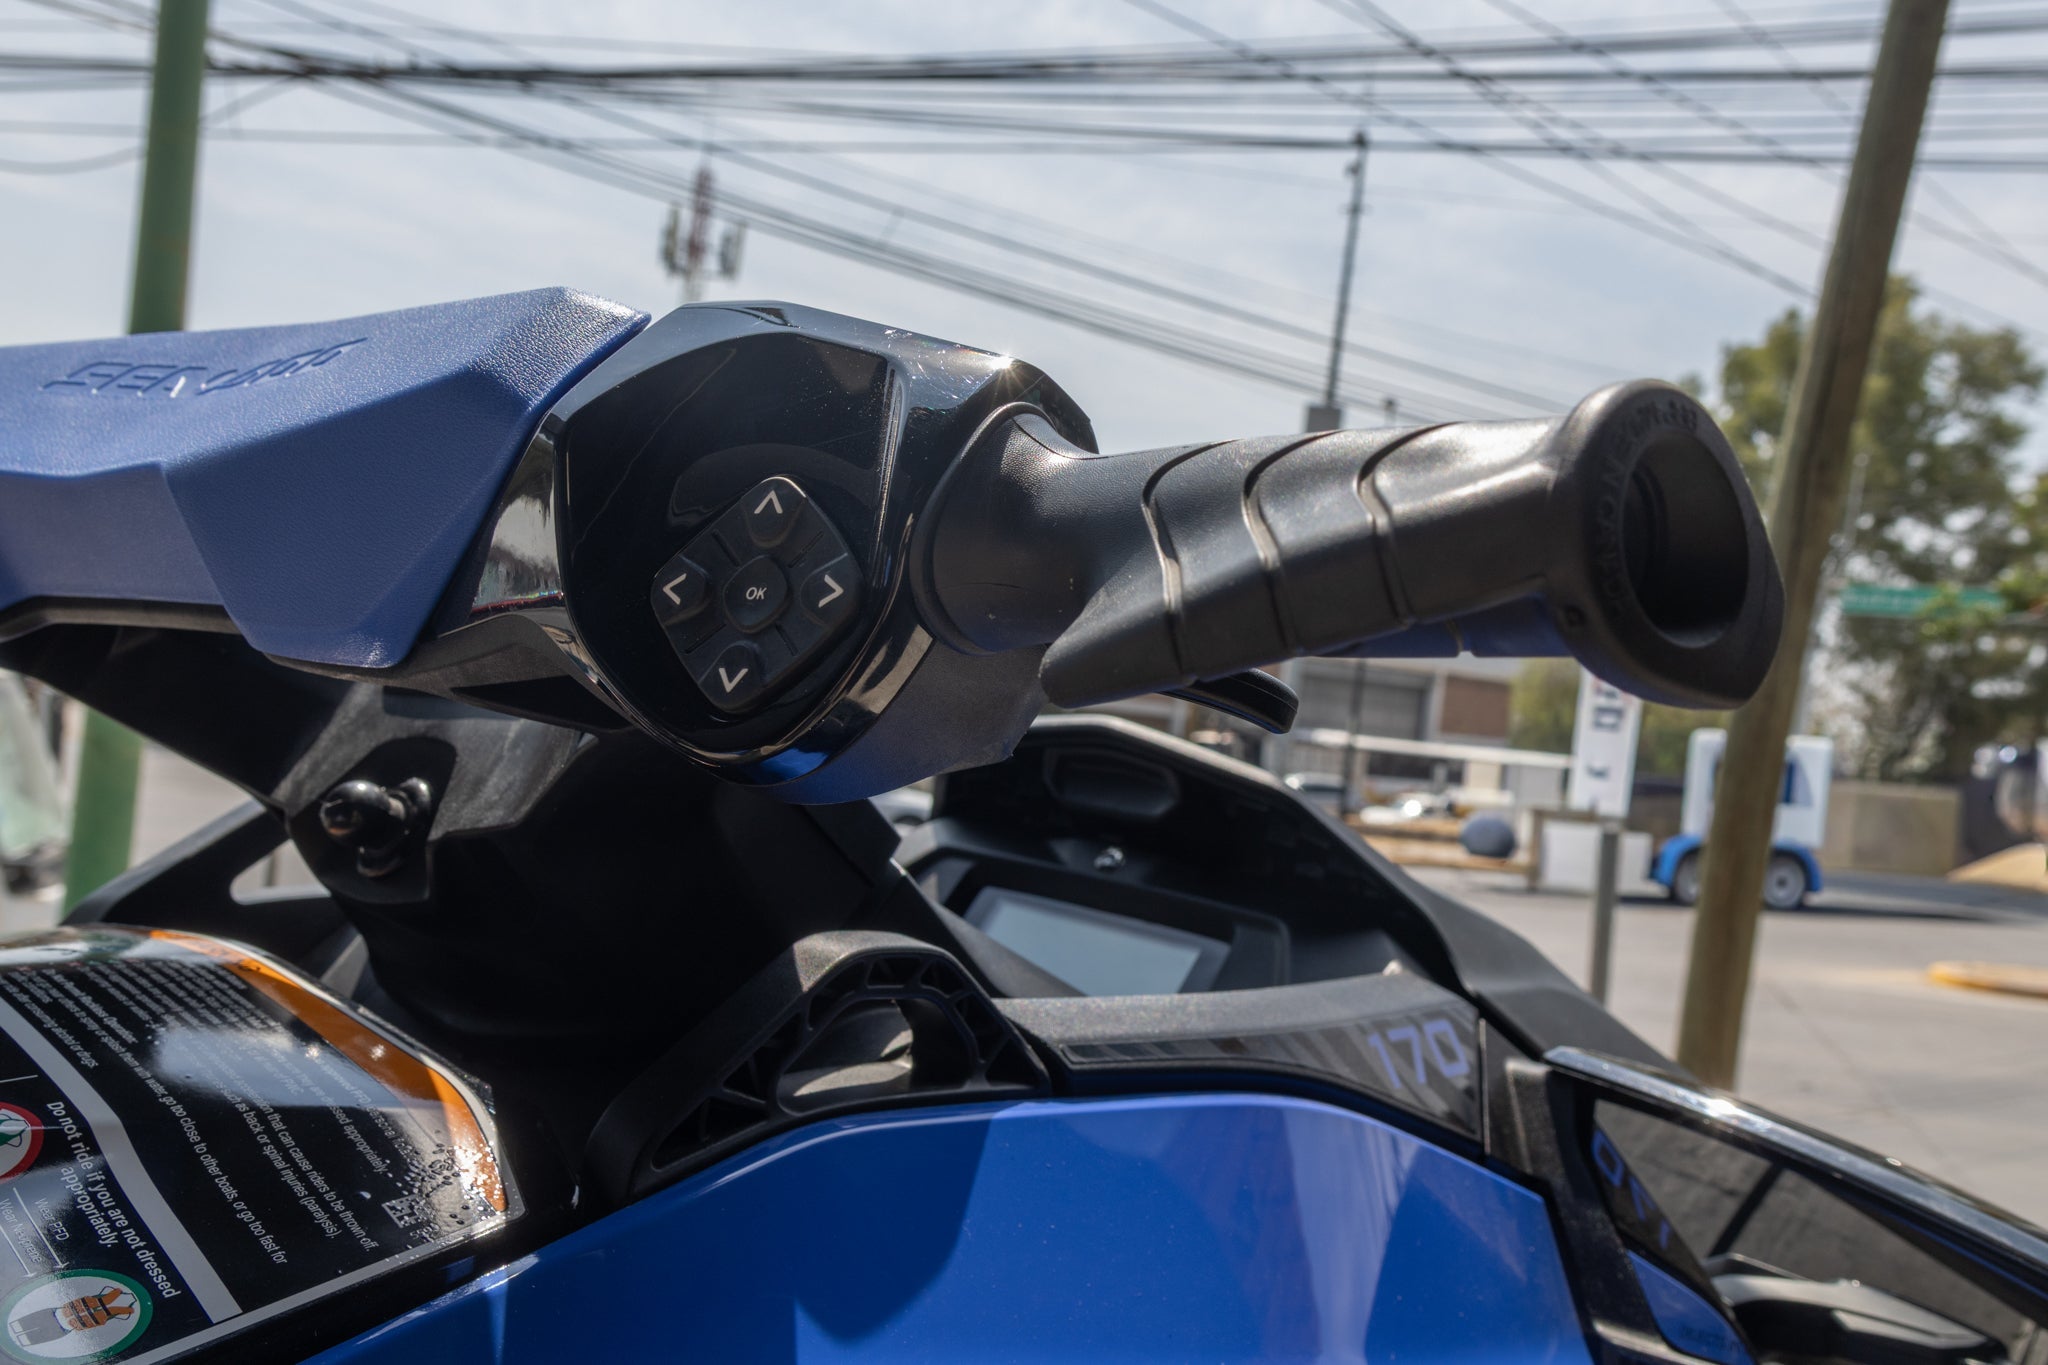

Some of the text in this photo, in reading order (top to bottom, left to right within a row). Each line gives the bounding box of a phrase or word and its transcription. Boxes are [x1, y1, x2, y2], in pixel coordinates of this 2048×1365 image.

[745, 587, 767, 600] OK
[1368, 1018, 1470, 1090] 170
[159, 1095, 177, 1107] go
[171, 1104, 187, 1118] too
[180, 1117, 201, 1143] close
[195, 1143, 208, 1154] to
[344, 1121, 388, 1175] appropriately.
[200, 1152, 222, 1176] other
[220, 1088, 342, 1239] such as back or spinal injuries (paralysis).
[215, 1175, 239, 1203] boats,
[267, 1111, 286, 1132] that
[278, 1128, 296, 1148] can
[290, 1146, 313, 1172] cause
[308, 1169, 330, 1194] riders
[324, 1191, 337, 1202] to
[332, 1200, 346, 1212] be
[340, 1211, 367, 1241] thrown
[360, 1235, 380, 1252] off.
[0, 1198, 18, 1223] Wear
[47, 1101, 182, 1299] Do not ride if you are not dressed
[61, 1166, 120, 1248] appropriately.
[233, 1200, 245, 1211] or
[35, 1197, 71, 1242] Wear PFD
[236, 1208, 255, 1223] go
[249, 1220, 266, 1236] too
[259, 1234, 281, 1256] fast
[271, 1251, 288, 1265] for
